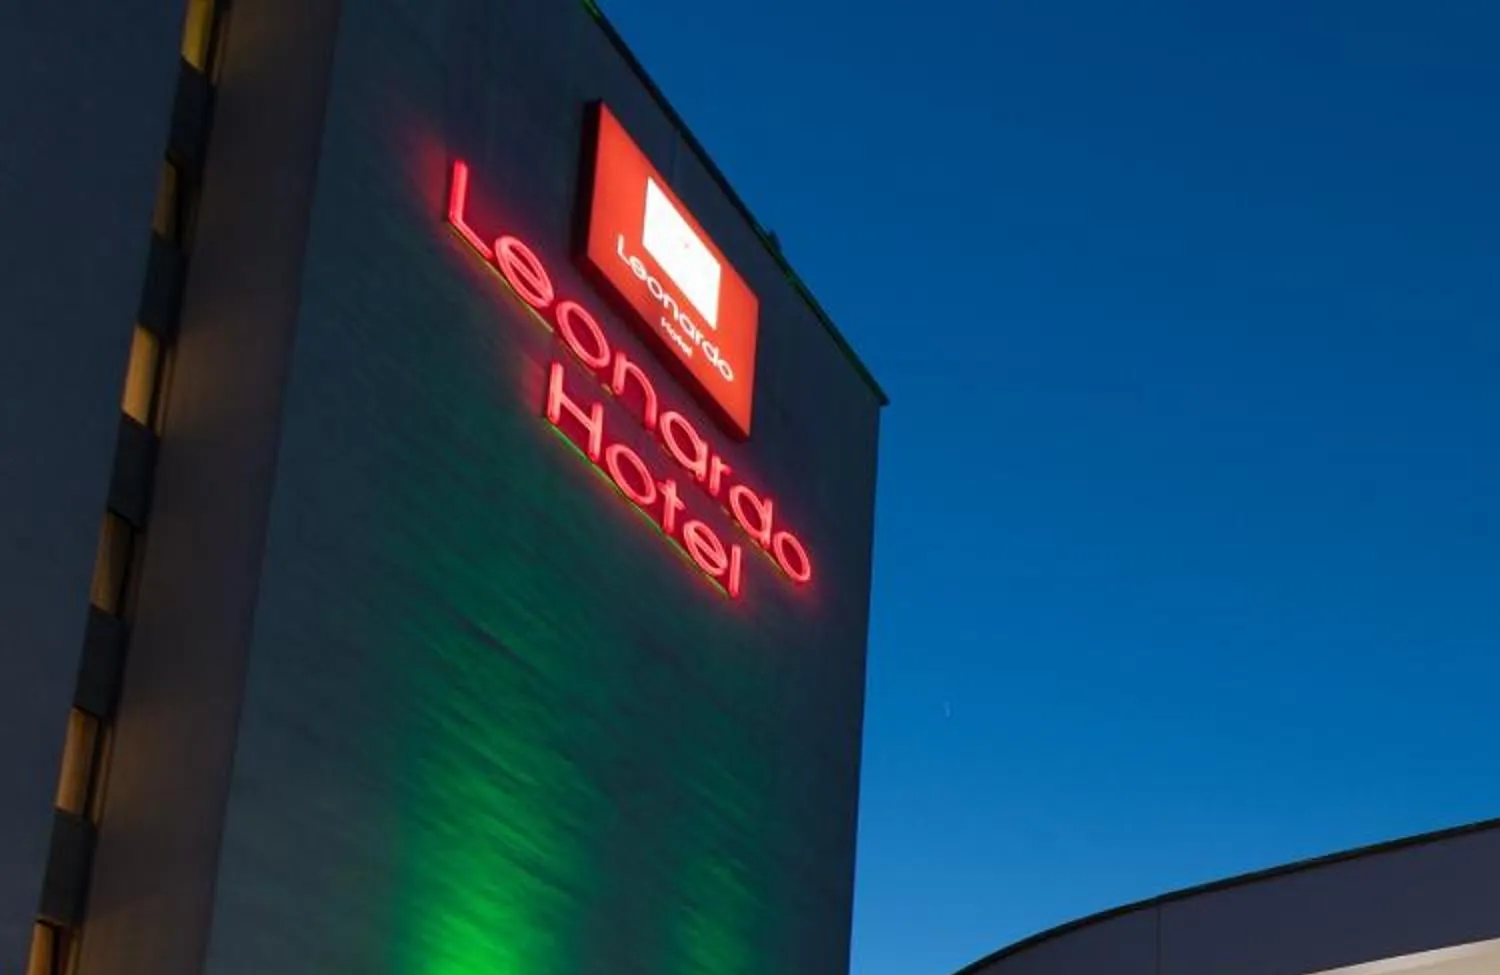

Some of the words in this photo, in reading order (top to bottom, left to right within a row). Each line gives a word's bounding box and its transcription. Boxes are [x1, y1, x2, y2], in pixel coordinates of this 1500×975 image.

[449, 160, 811, 581] Leonardo
[617, 234, 734, 382] Leonardo
[546, 362, 741, 596] Hotel
